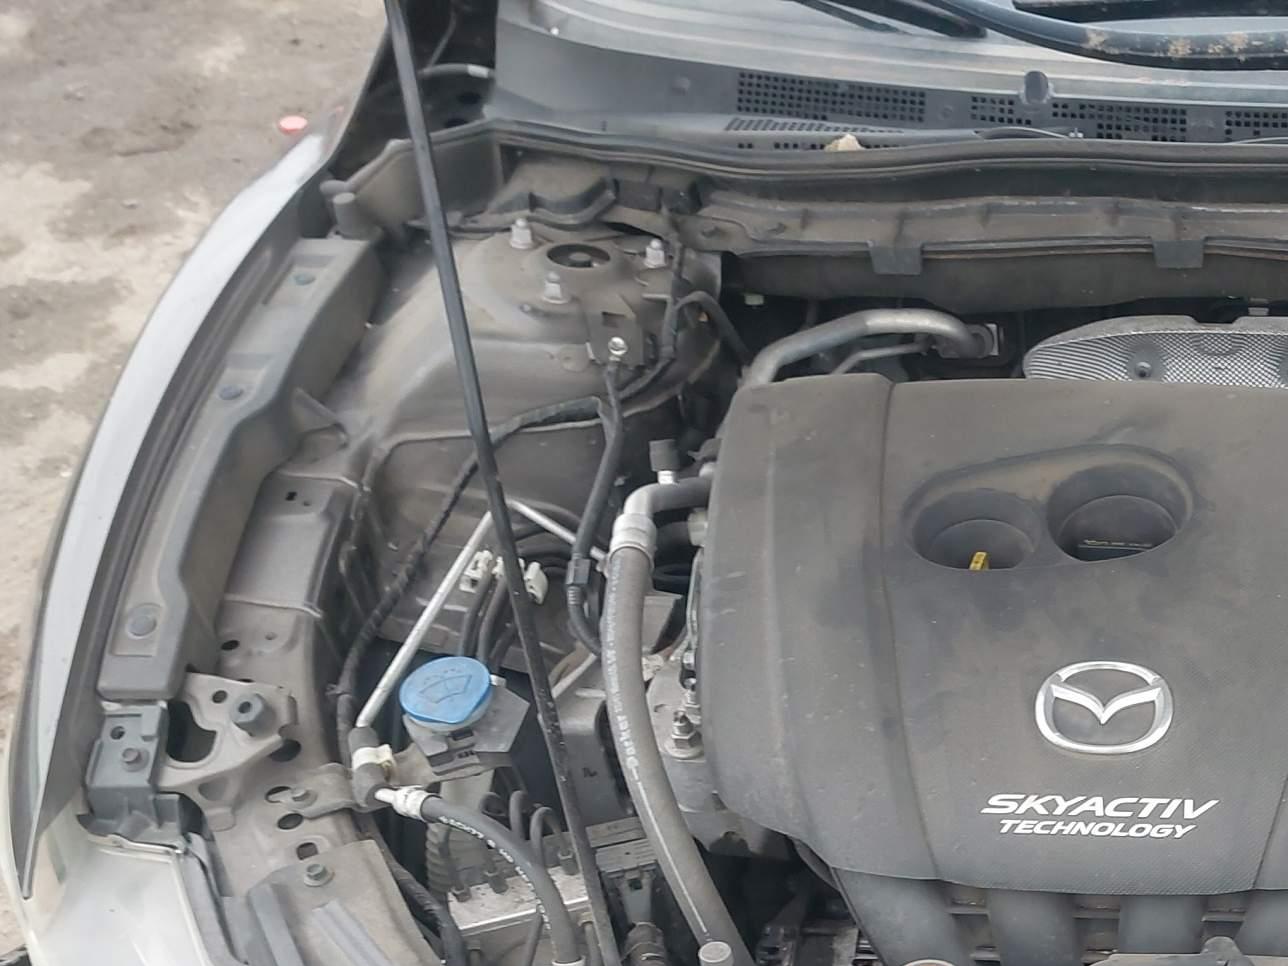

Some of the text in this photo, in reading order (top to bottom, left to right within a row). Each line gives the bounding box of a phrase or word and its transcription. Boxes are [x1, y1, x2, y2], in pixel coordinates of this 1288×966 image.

[617, 715, 639, 769] Parker
[980, 793, 1220, 819] SKYACTIV
[1000, 819, 1197, 839] TECHNOLOGY
